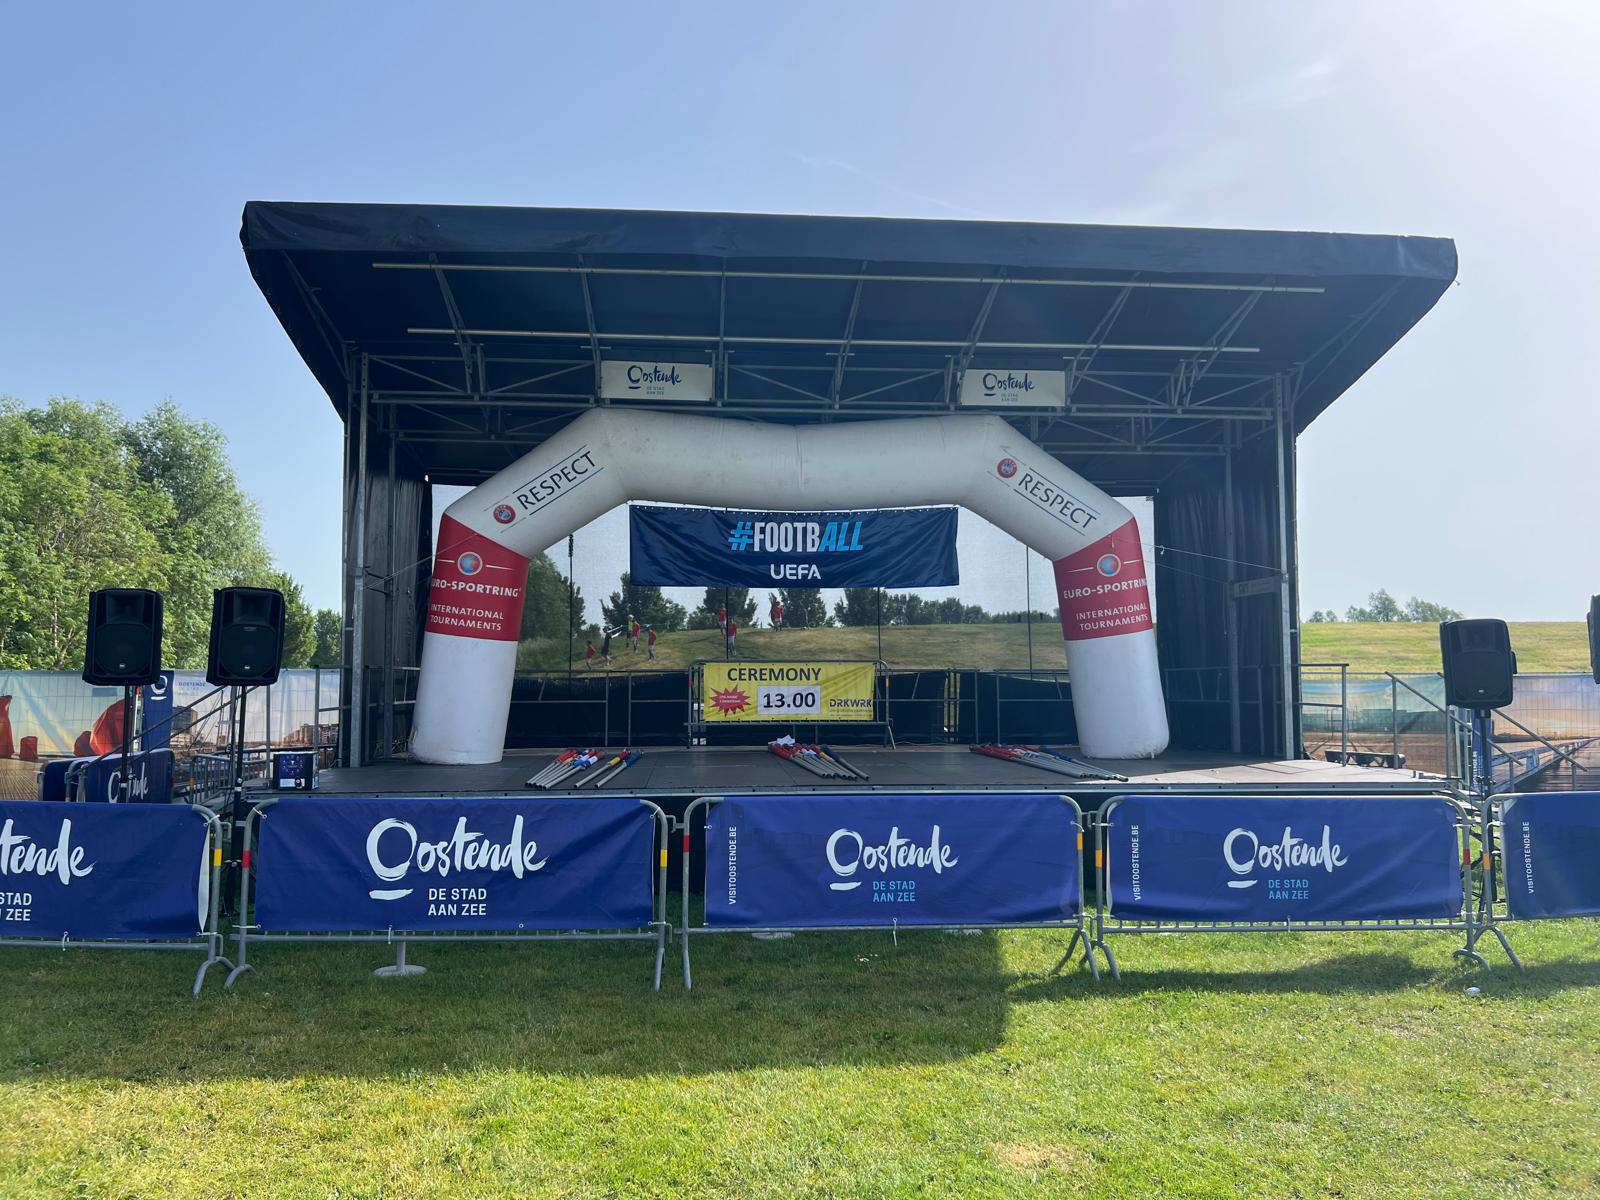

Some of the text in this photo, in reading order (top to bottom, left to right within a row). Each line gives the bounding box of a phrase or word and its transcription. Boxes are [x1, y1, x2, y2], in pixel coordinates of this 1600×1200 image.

[627, 365, 682, 385] Oostende
[982, 372, 1035, 392] Oostende
[516, 450, 596, 510] RESPECT
[1018, 473, 1097, 528] RESPECT
[728, 521, 864, 552] #FOOTBALL
[770, 564, 821, 580] UEFA
[431, 578, 518, 597] URO-SPORTRING
[1063, 578, 1147, 599] EURO-SPORTRIN
[430, 603, 504, 620] INTERNATIONAL
[1076, 602, 1147, 620] INTERNATIONAL
[430, 615, 502, 631] TOURNAMENTS
[1080, 614, 1148, 631] TOURNAMENTS
[727, 667, 822, 681] CEREMONY
[763, 692, 816, 709] 13.00
[0, 818, 97, 885] tende
[366, 814, 549, 882] Oostende
[826, 824, 959, 876] Oostende
[1223, 824, 1349, 875] Oostende
[728, 826, 737, 905] VISITOOSTENDE.BE
[1131, 825, 1142, 901] VISITOOSTENDE.BE
[1522, 821, 1534, 894] VISITOOSTENDE.BE
[872, 881, 916, 890] DE STAD
[1268, 880, 1309, 889] DE STAD
[428, 888, 487, 900] DE STAD
[872, 892, 916, 902] AAN ZEE
[1268, 890, 1309, 900] AAN ZEE
[5, 908, 31, 921] ZEE
[428, 903, 487, 916] AAN ZEE
